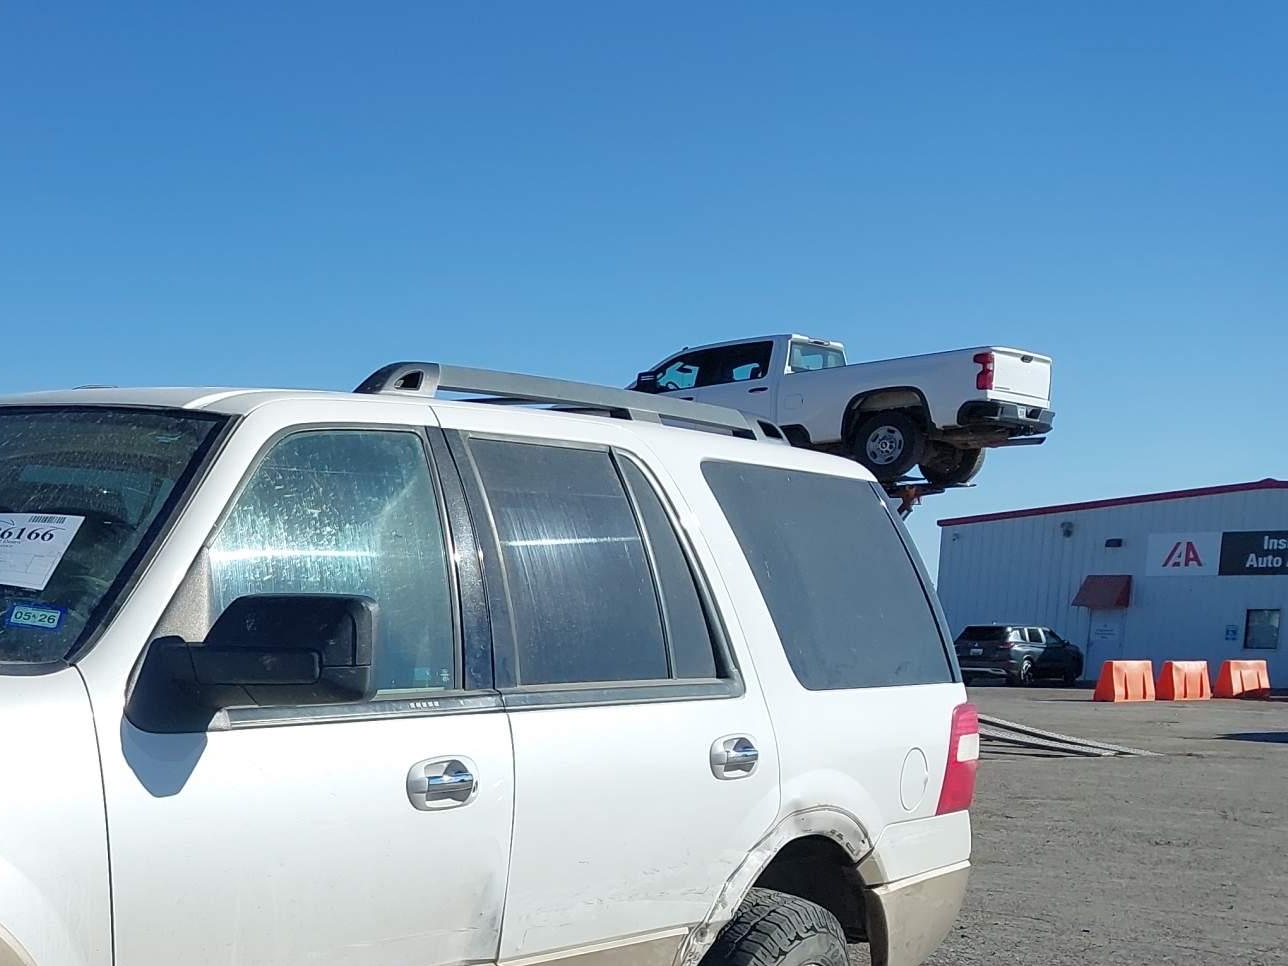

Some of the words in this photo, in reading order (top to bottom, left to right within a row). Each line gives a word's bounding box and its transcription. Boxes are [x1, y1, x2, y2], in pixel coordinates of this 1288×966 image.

[1263, 535, 1288, 550] Ins
[1245, 553, 1282, 568] Auto
[14, 610, 32, 621] 05
[38, 613, 56, 624] 26
